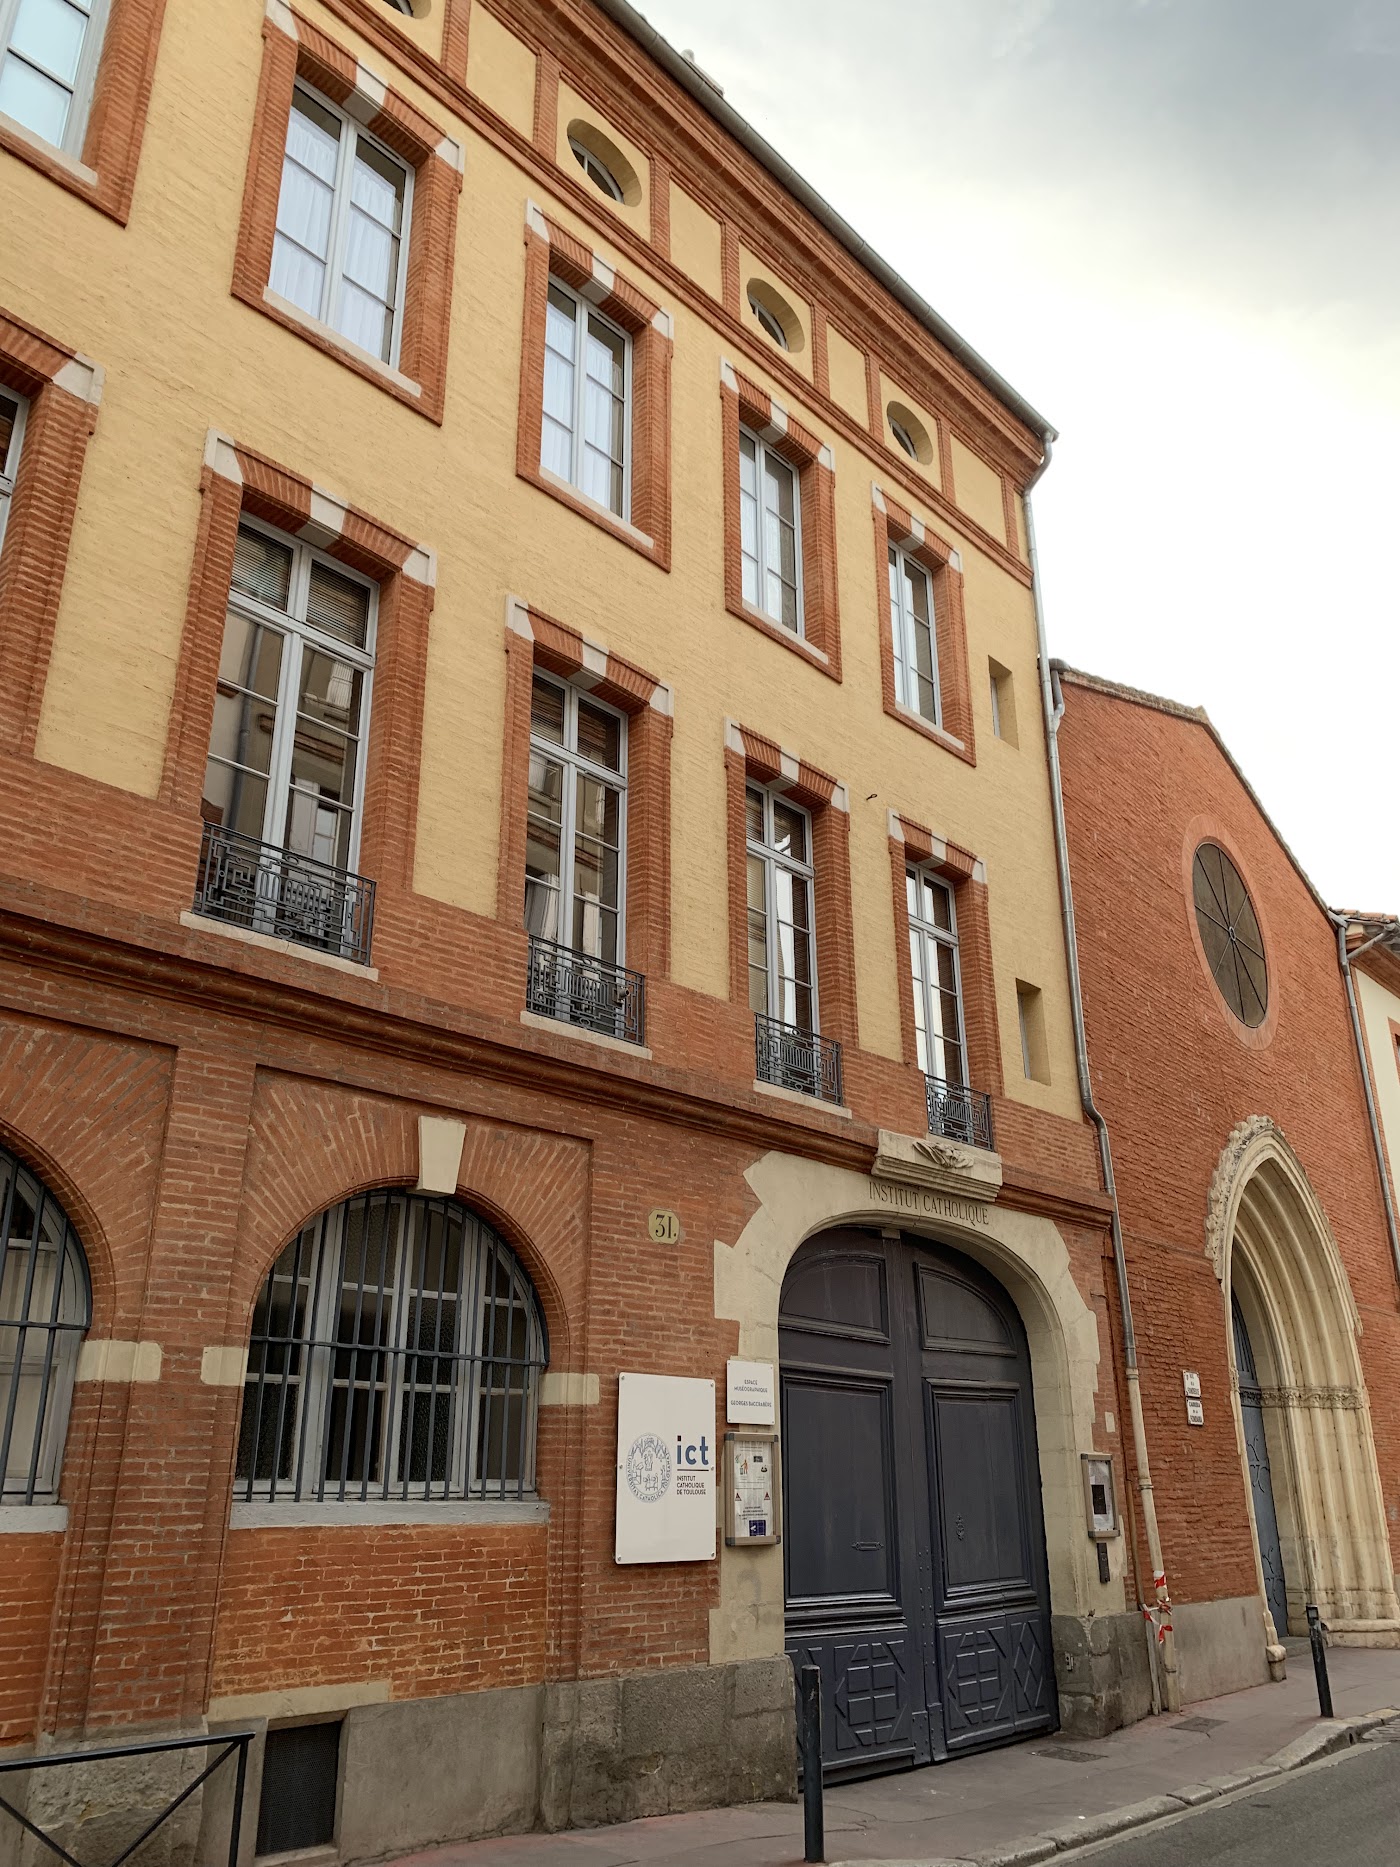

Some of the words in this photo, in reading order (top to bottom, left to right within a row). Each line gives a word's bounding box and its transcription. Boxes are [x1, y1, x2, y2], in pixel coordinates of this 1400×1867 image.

[869, 1181, 918, 1209] INSTITUT
[923, 1194, 989, 1226] CATHOLIQUE
[677, 1435, 709, 1466] ict
